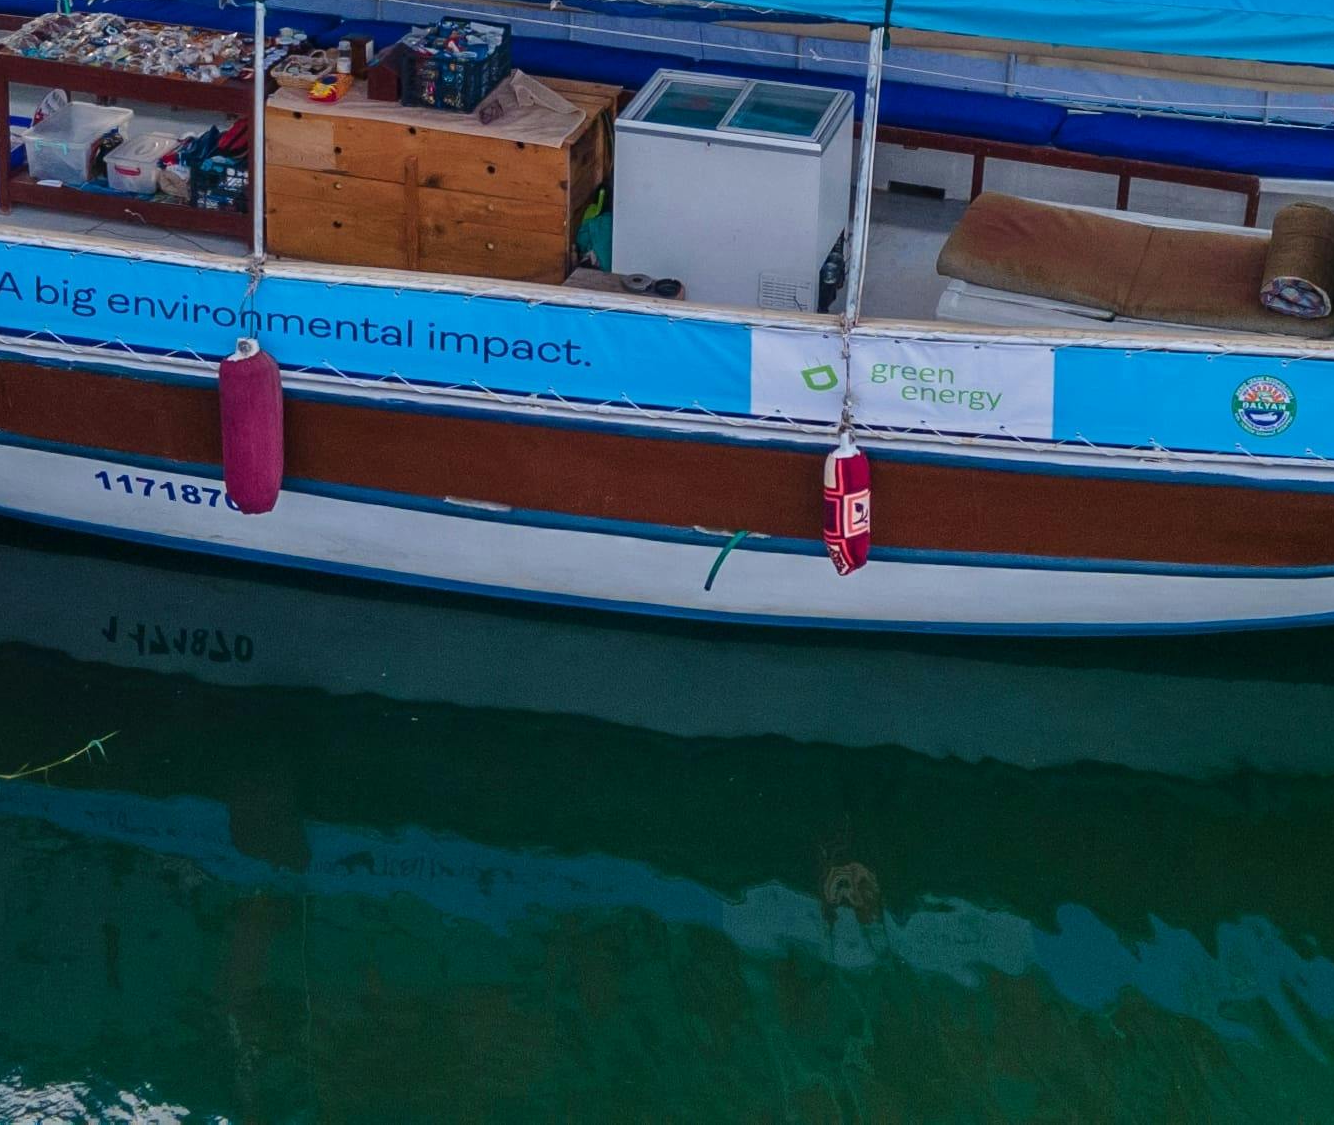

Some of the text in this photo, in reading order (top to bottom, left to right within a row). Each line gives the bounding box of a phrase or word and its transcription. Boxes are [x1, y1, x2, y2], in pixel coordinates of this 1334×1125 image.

[36, 275, 97, 317] big
[107, 293, 414, 348] environmental
[429, 323, 592, 367] impact.
[871, 362, 955, 384] green
[901, 385, 1002, 411] energy
[1242, 402, 1287, 411] DALYAN
